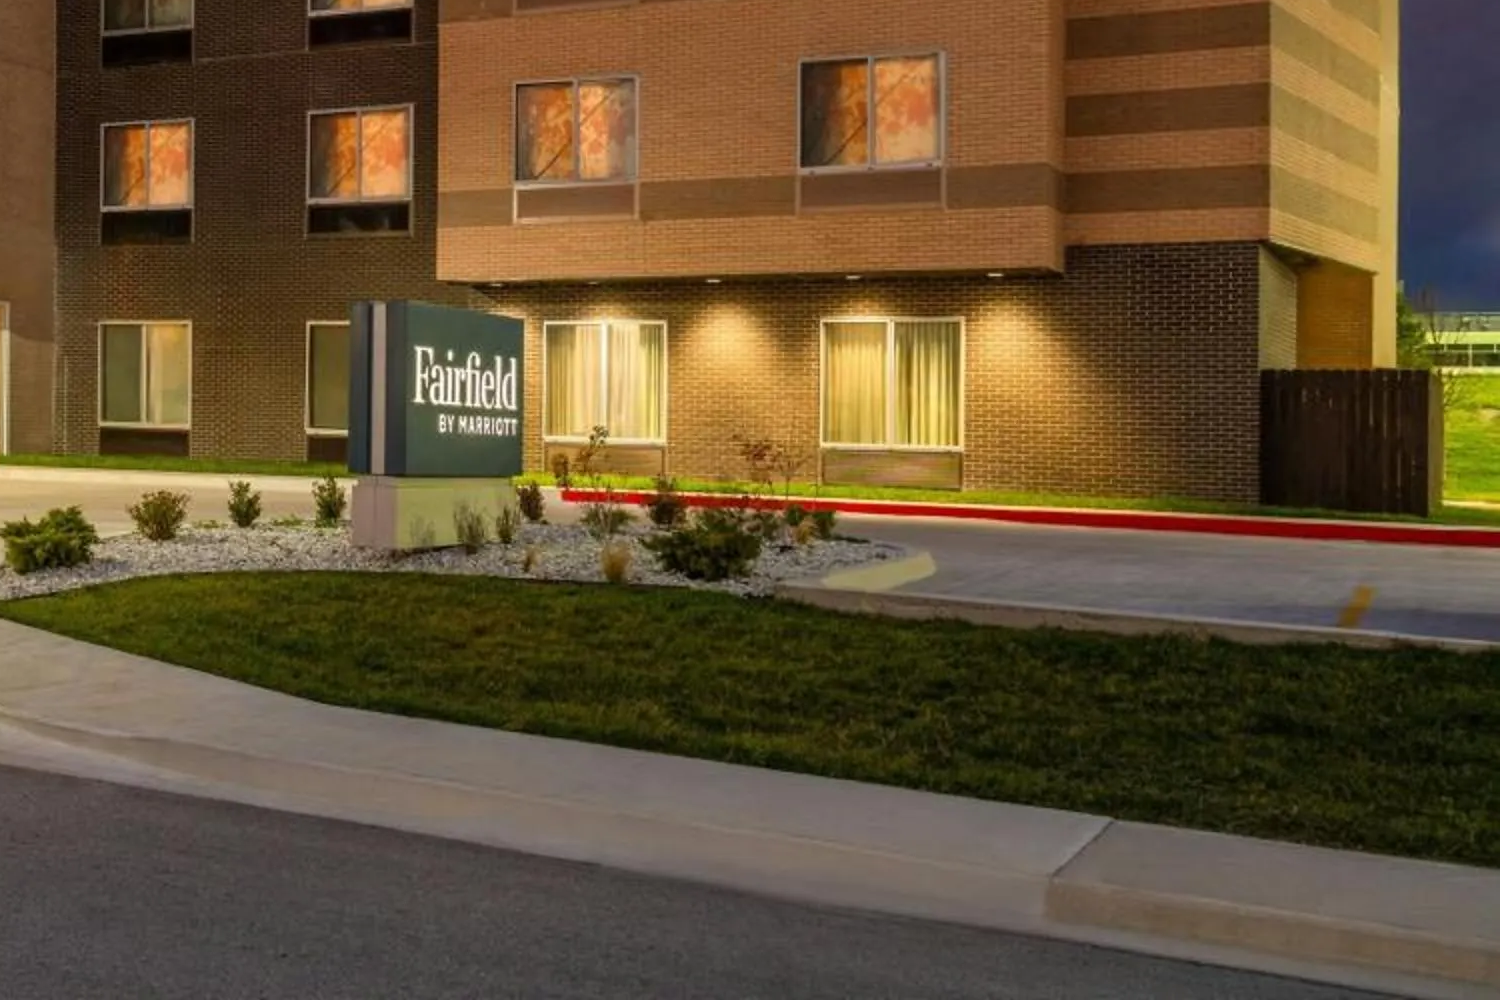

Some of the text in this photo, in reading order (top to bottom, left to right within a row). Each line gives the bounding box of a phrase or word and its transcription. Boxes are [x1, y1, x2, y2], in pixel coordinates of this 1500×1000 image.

[413, 345, 518, 410] Fairfield
[438, 413, 518, 436] BY MARRIOTT
